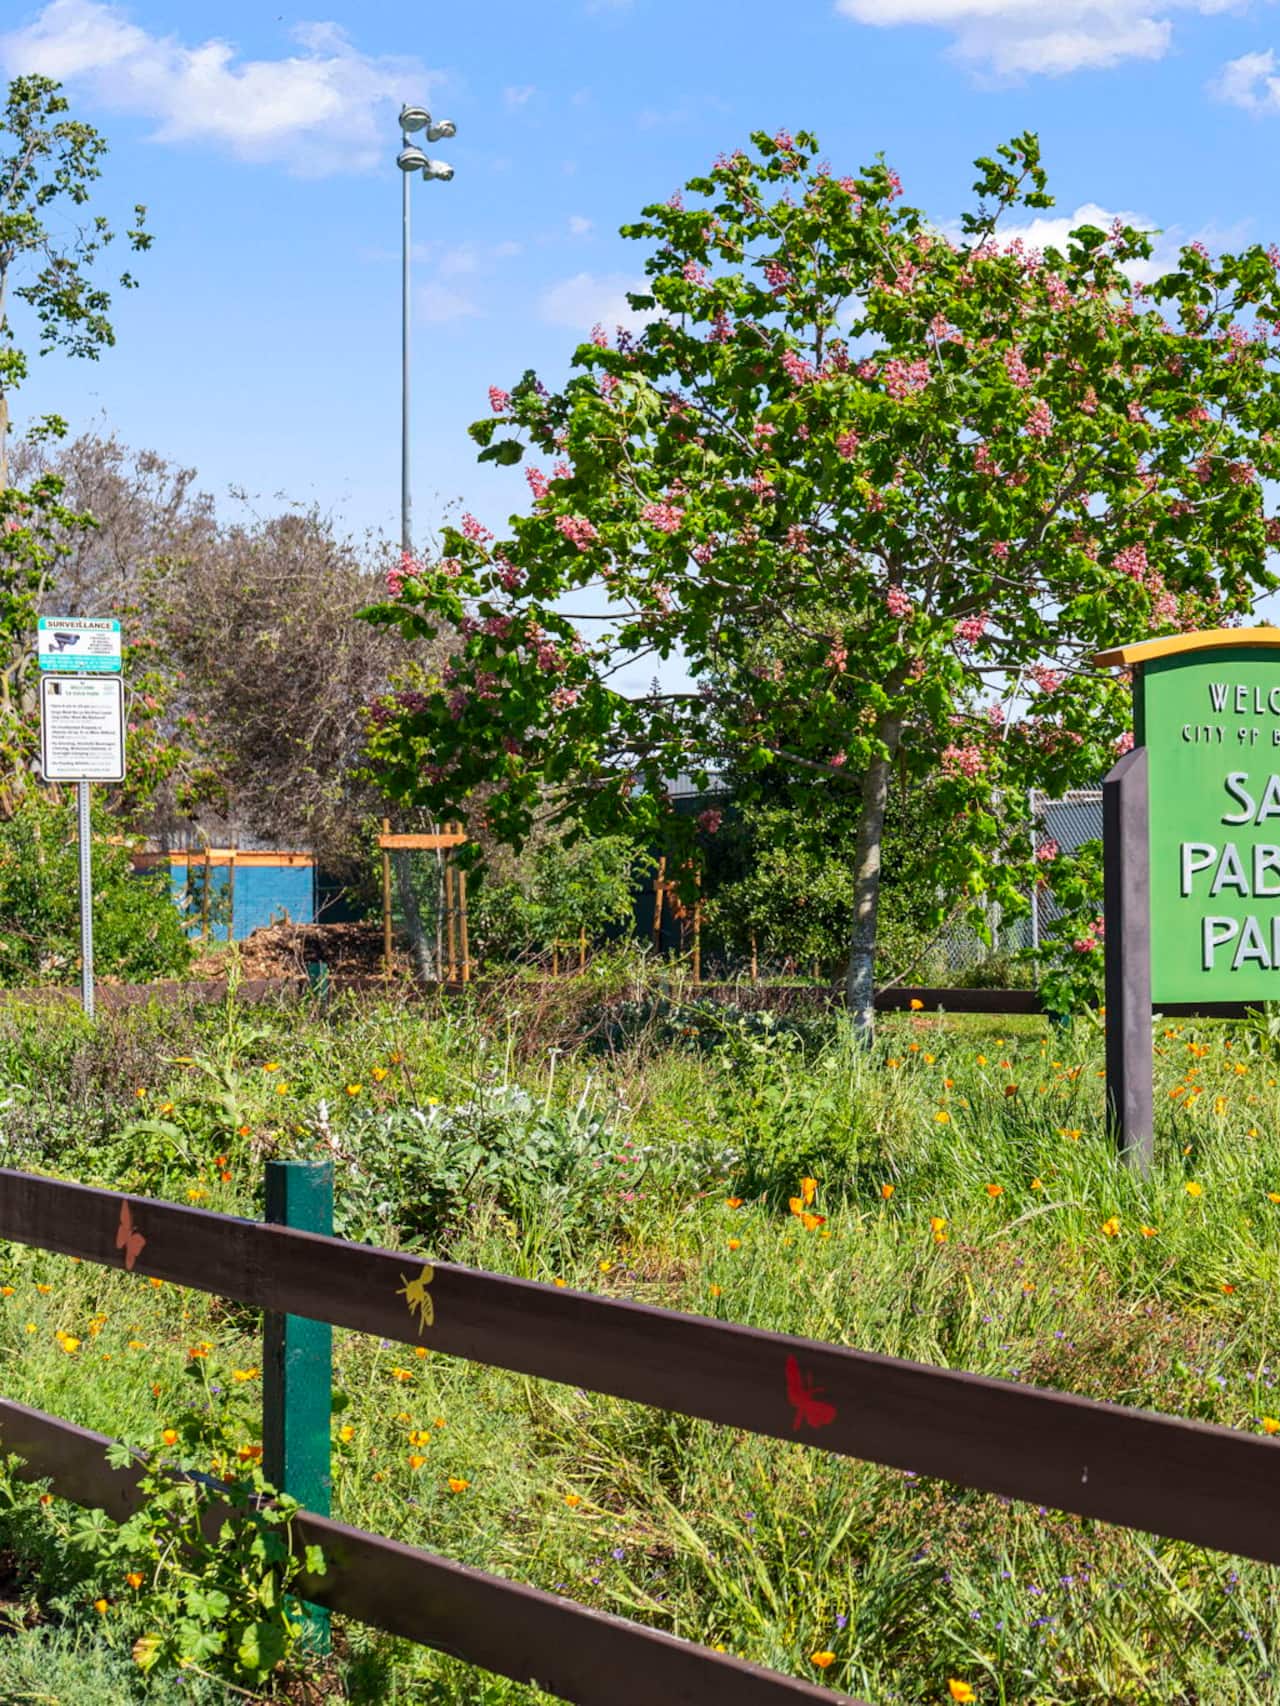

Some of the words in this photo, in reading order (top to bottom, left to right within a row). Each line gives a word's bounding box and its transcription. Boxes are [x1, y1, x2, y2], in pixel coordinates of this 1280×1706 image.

[47, 620, 112, 630] SURVEILLANCE
[1182, 724, 1225, 744] CITY
[1237, 728, 1260, 746] OF
